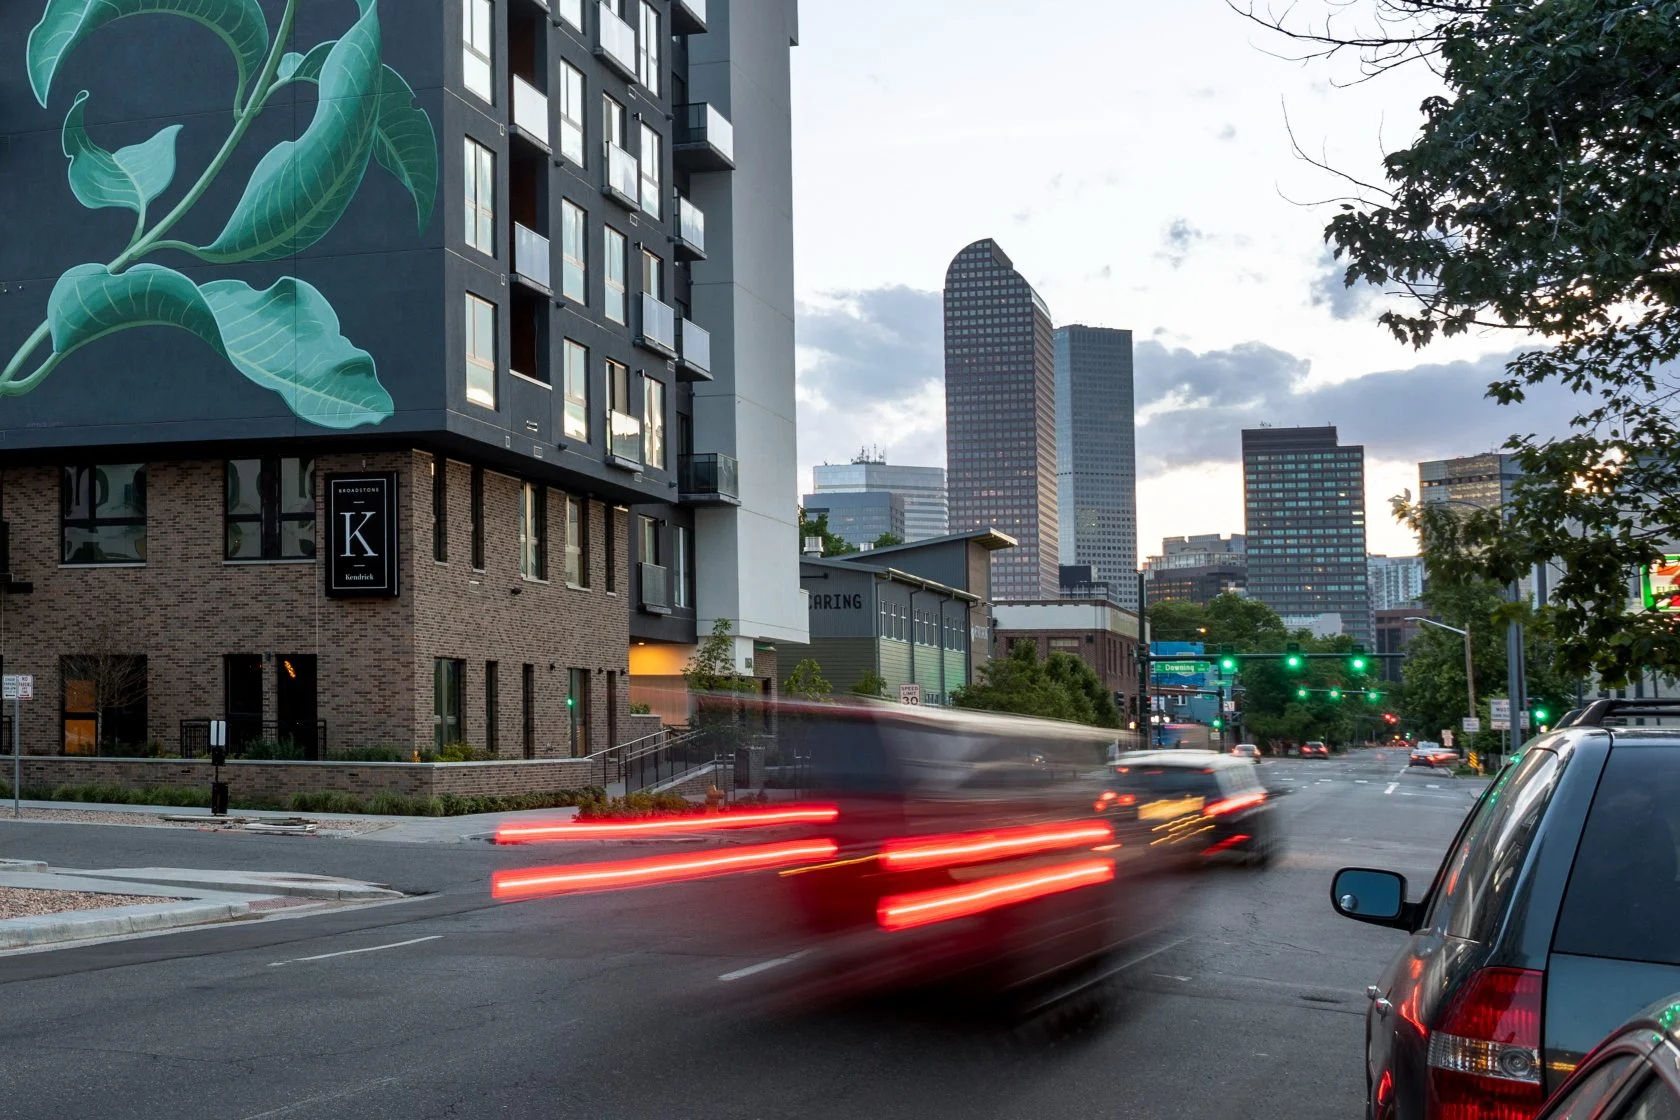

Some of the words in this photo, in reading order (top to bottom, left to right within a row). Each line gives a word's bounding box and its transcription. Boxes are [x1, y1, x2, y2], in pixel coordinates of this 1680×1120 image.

[339, 511, 379, 557] K
[345, 573, 374, 581] Kendrick
[1165, 664, 1195, 672] Downing
[902, 696, 918, 706] 30
